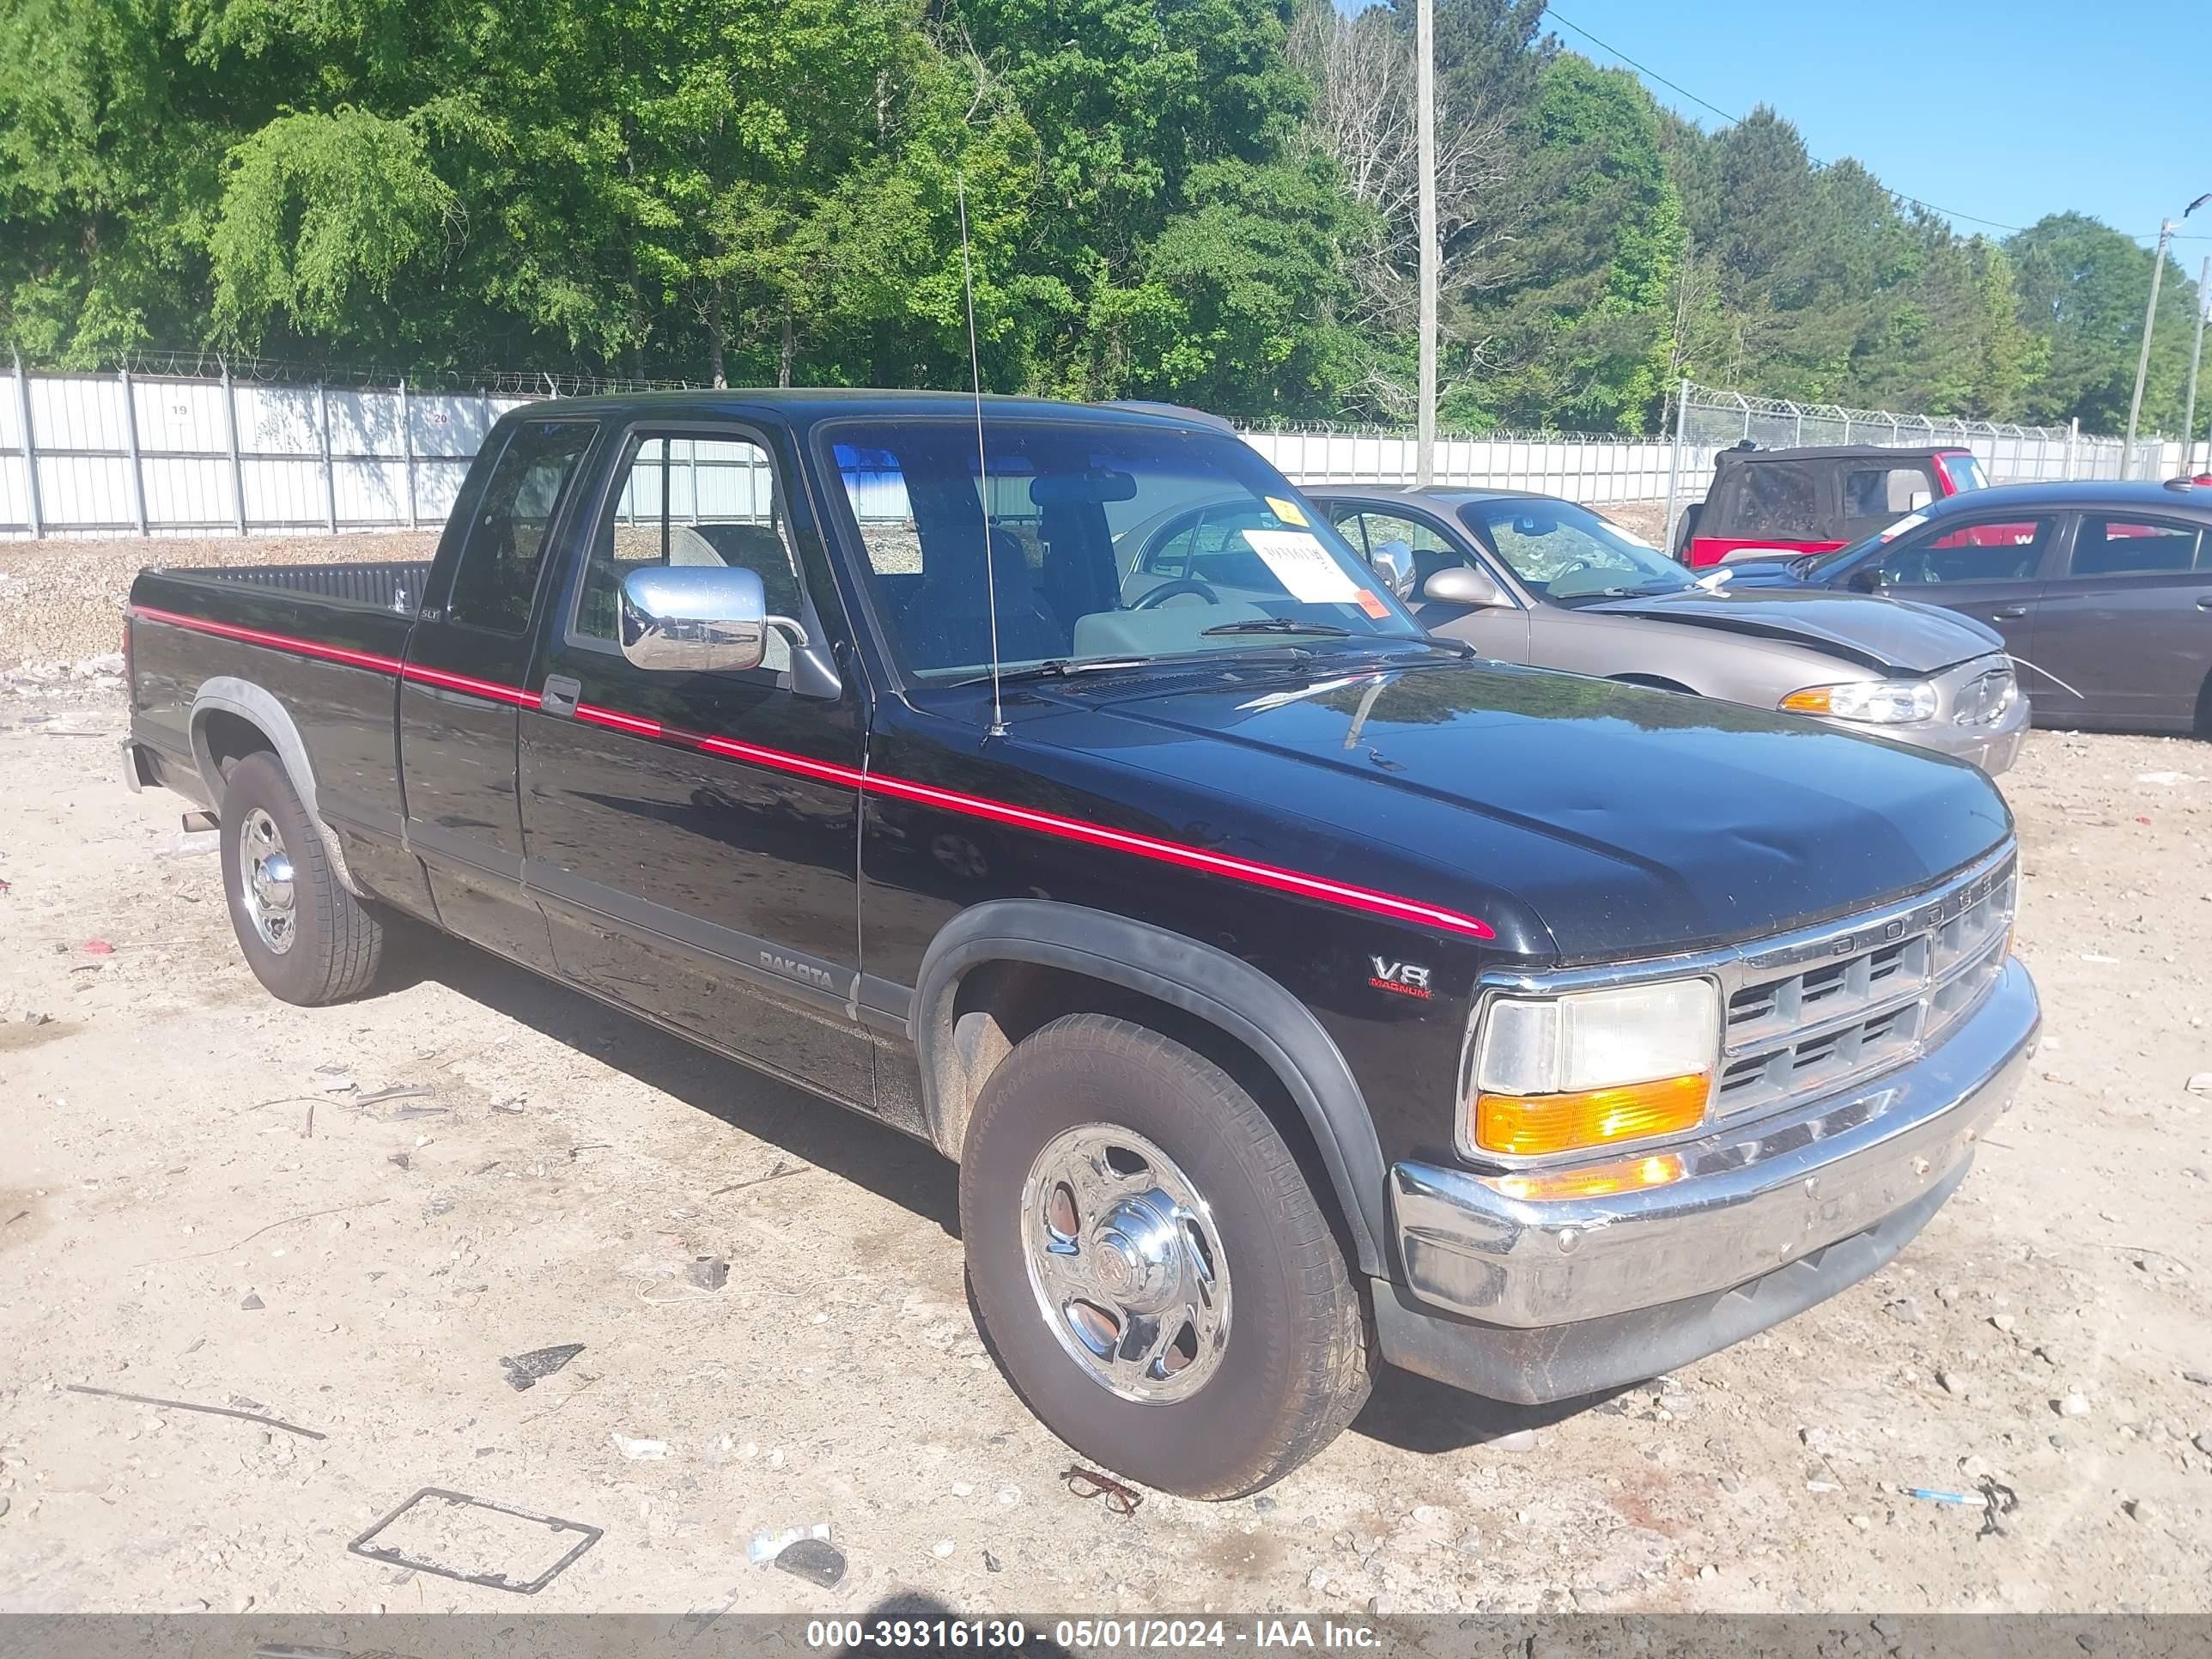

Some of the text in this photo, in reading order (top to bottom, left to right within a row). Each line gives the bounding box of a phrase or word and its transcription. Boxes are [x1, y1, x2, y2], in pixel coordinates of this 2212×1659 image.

[171, 404, 187, 416] 19
[434, 414, 447, 423] 20
[421, 609, 441, 619] SLT
[760, 951, 834, 988] DAKOTA
[1369, 955, 1430, 988] V8
[1371, 977, 1431, 998] MAGNUM
